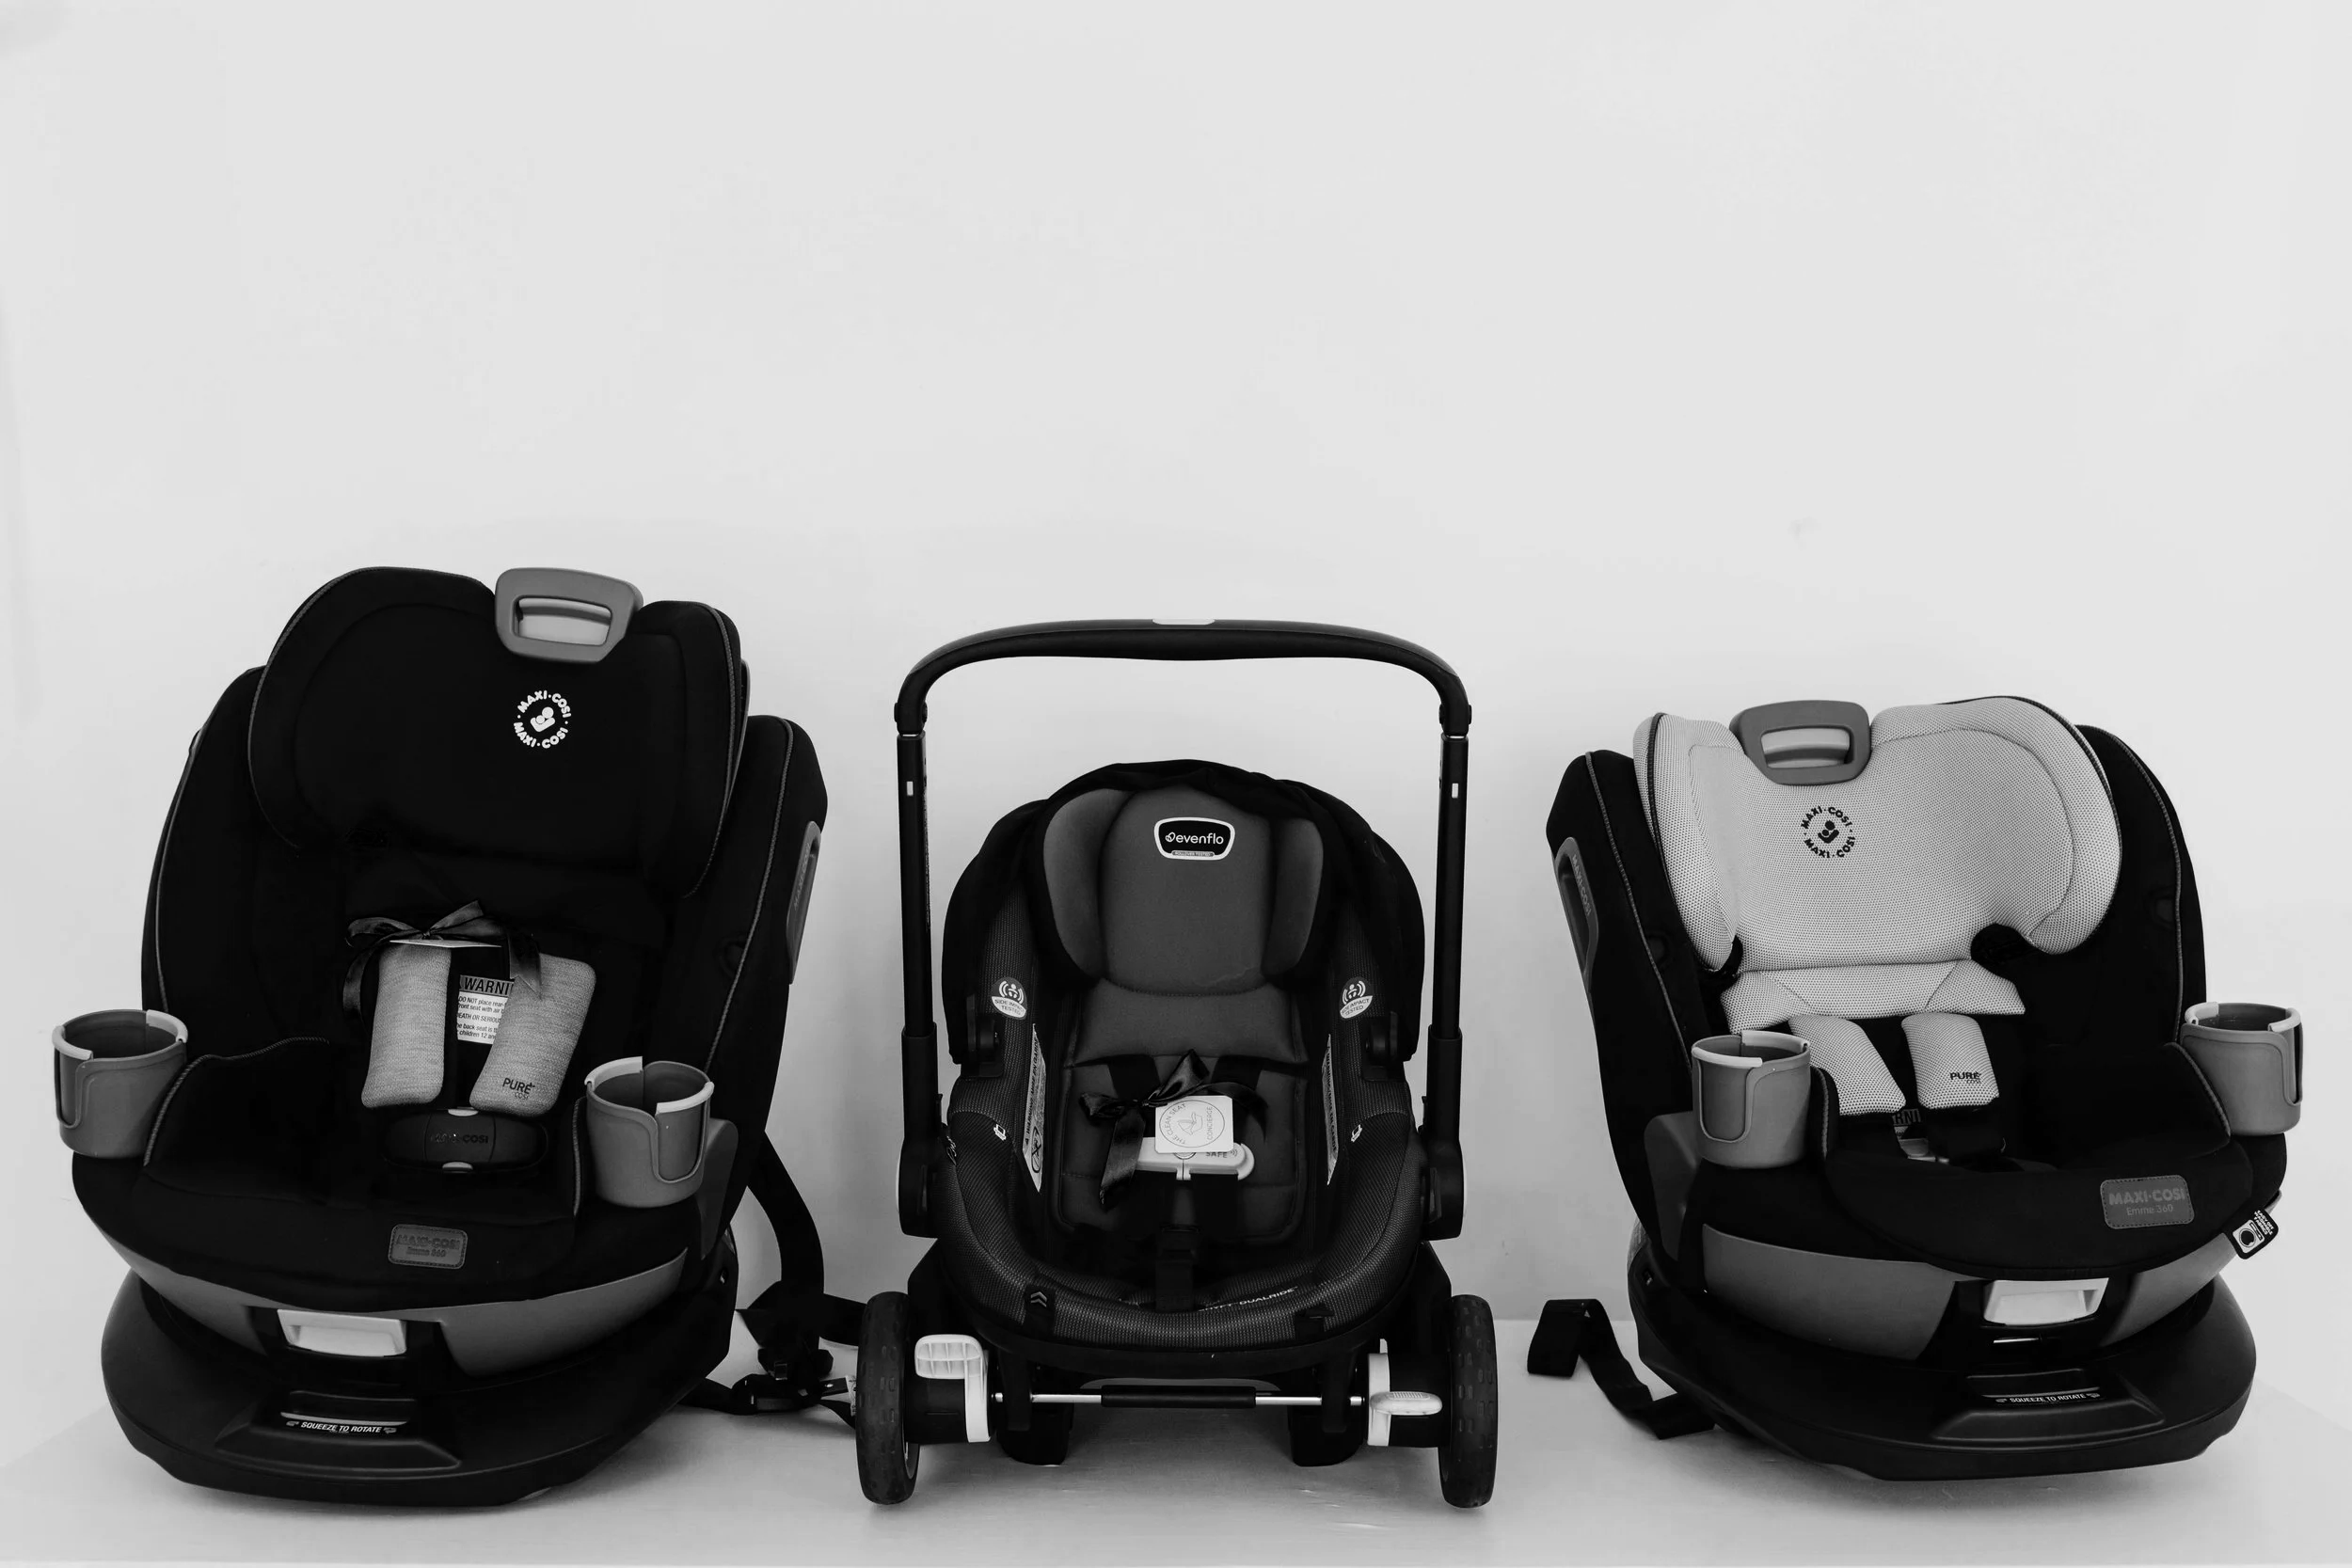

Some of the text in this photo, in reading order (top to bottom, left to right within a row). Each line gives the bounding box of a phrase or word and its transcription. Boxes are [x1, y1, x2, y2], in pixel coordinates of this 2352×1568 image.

[1175, 832, 1224, 845] evenflo
[465, 976, 513, 995] WARNI
[1164, 1115, 1174, 1135] CLEAN
[2126, 1203, 2173, 1215] Emme 360
[2058, 1393, 2087, 1402] ROTATE
[301, 1421, 338, 1432] SQUEEZE
